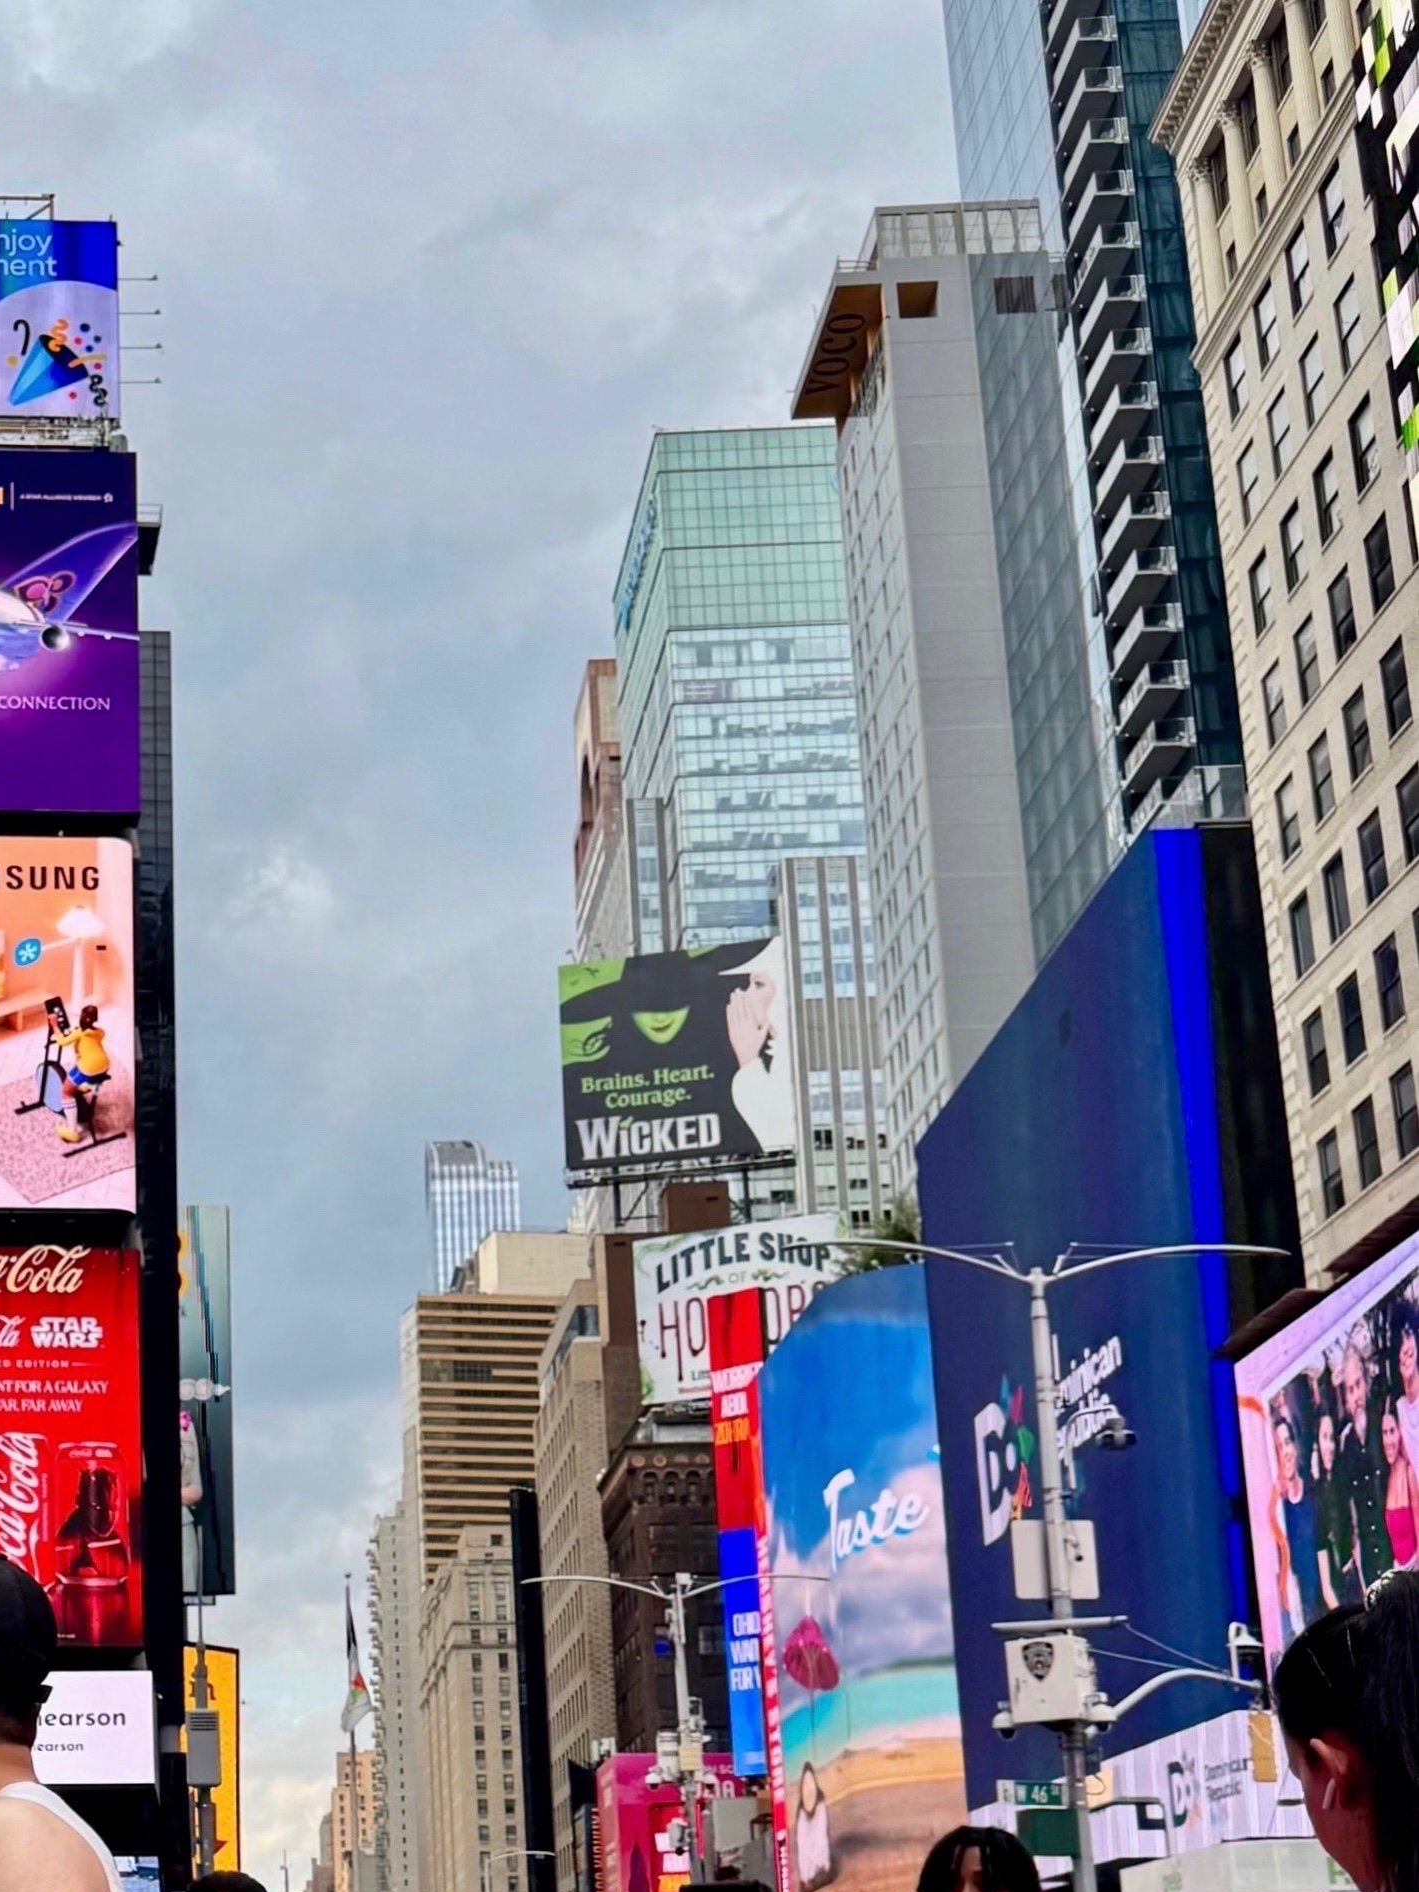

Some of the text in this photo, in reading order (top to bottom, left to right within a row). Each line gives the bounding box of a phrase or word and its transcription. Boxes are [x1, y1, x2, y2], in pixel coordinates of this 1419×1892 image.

[580, 1063, 715, 1094] Brains. Heart.
[604, 1086, 692, 1111] Courage.
[656, 1232, 832, 1294] LITTLE SHOP
[728, 1273, 748, 1284] OF
[31, 1316, 102, 1333] STAR
[31, 1331, 102, 1348] WARS
[16, 1360, 70, 1369] EDITION
[15, 1380, 41, 1393] FOR
[44, 1381, 53, 1393] A
[54, 1381, 109, 1394] GALAXY
[22, 1399, 46, 1412] FAR
[48, 1400, 84, 1413] AWAY
[824, 1469, 931, 1573] Taste
[34, 1741, 84, 1752] earson
[1031, 1785, 1048, 1804] 46
